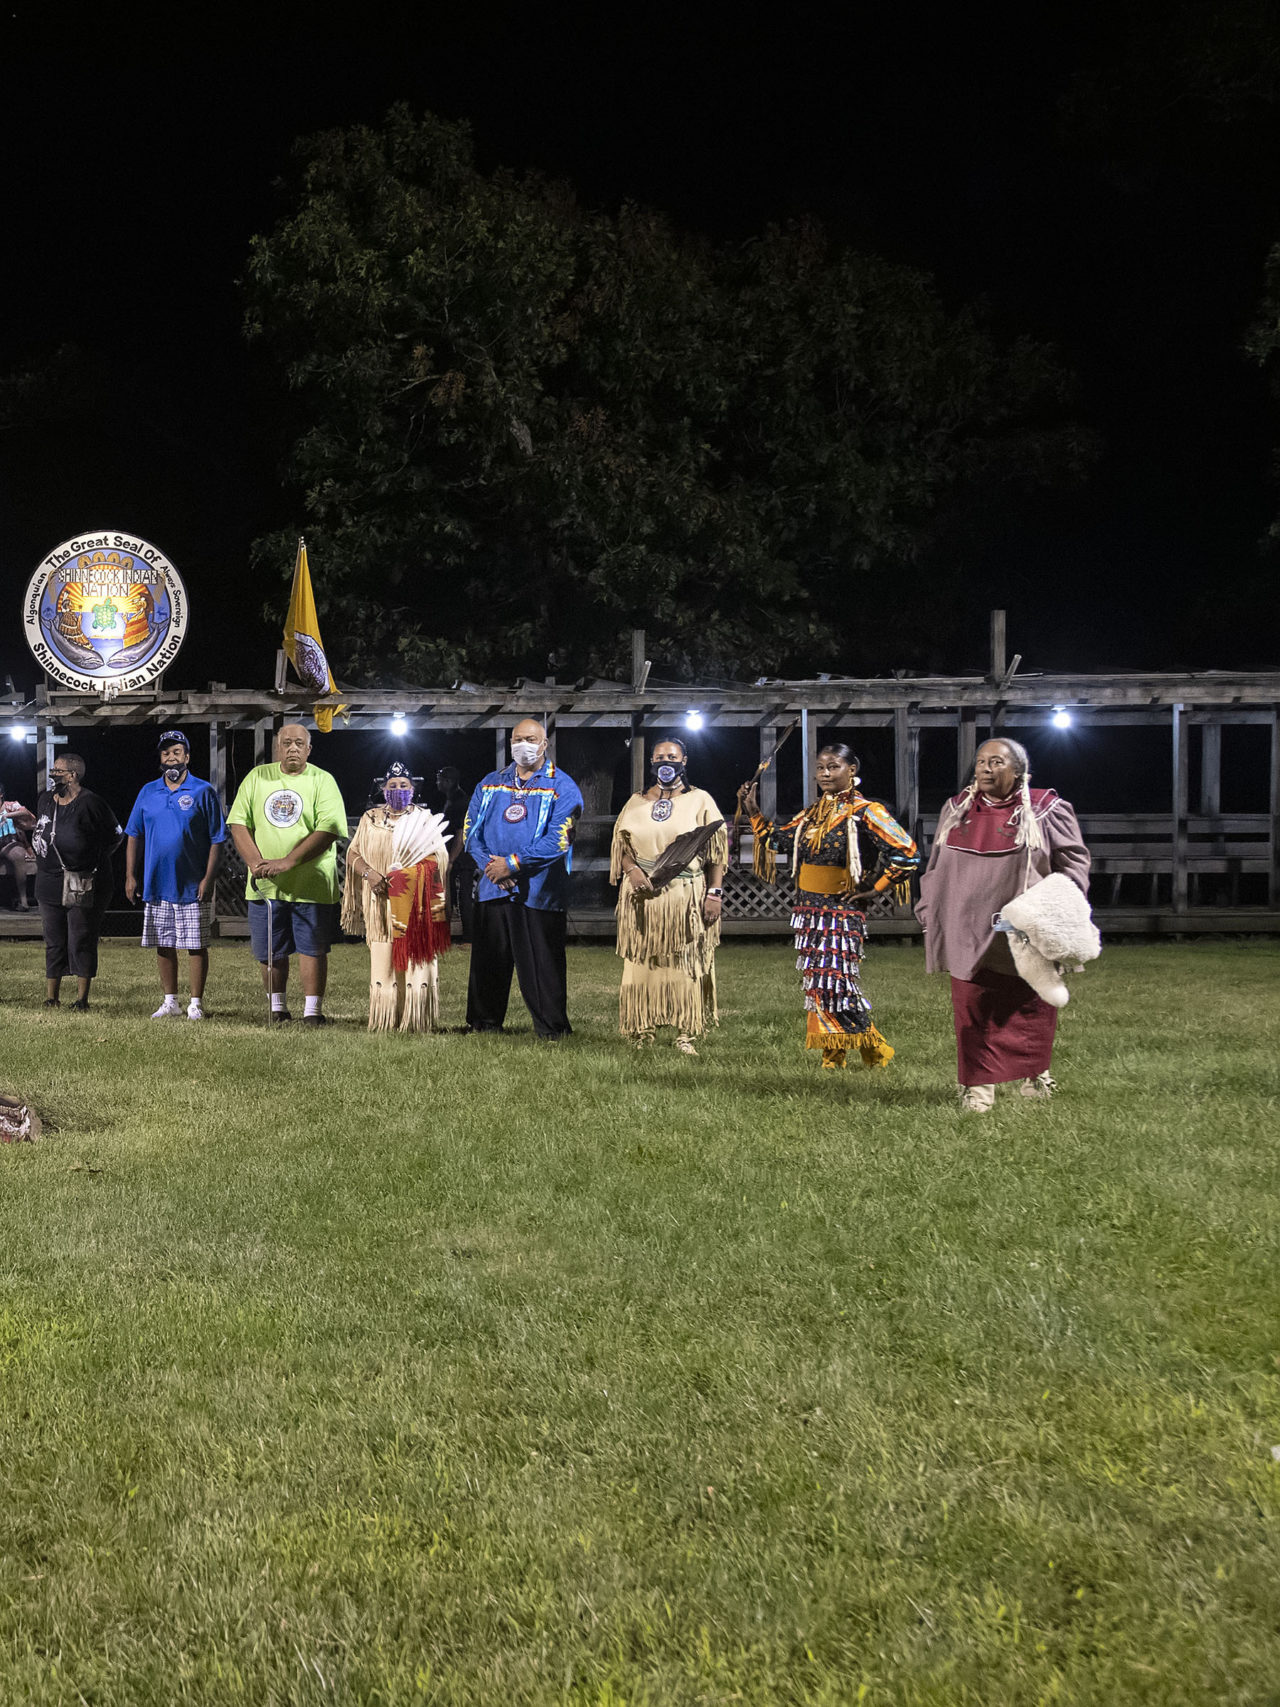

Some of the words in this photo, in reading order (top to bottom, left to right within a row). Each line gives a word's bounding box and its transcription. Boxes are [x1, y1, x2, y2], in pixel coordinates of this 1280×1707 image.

[45, 549, 72, 569] The
[70, 536, 109, 553] Great
[113, 536, 144, 554] Seal
[143, 549, 161, 565] Of
[26, 572, 47, 625] Algonquian
[58, 569, 120, 583] SHINNECOCK
[122, 569, 158, 585] INDIAN
[82, 583, 130, 597] NATION
[160, 565, 176, 588] Always
[171, 590, 182, 628] Sovereign
[33, 643, 97, 691] Shinnecock
[145, 636, 181, 677] Nation
